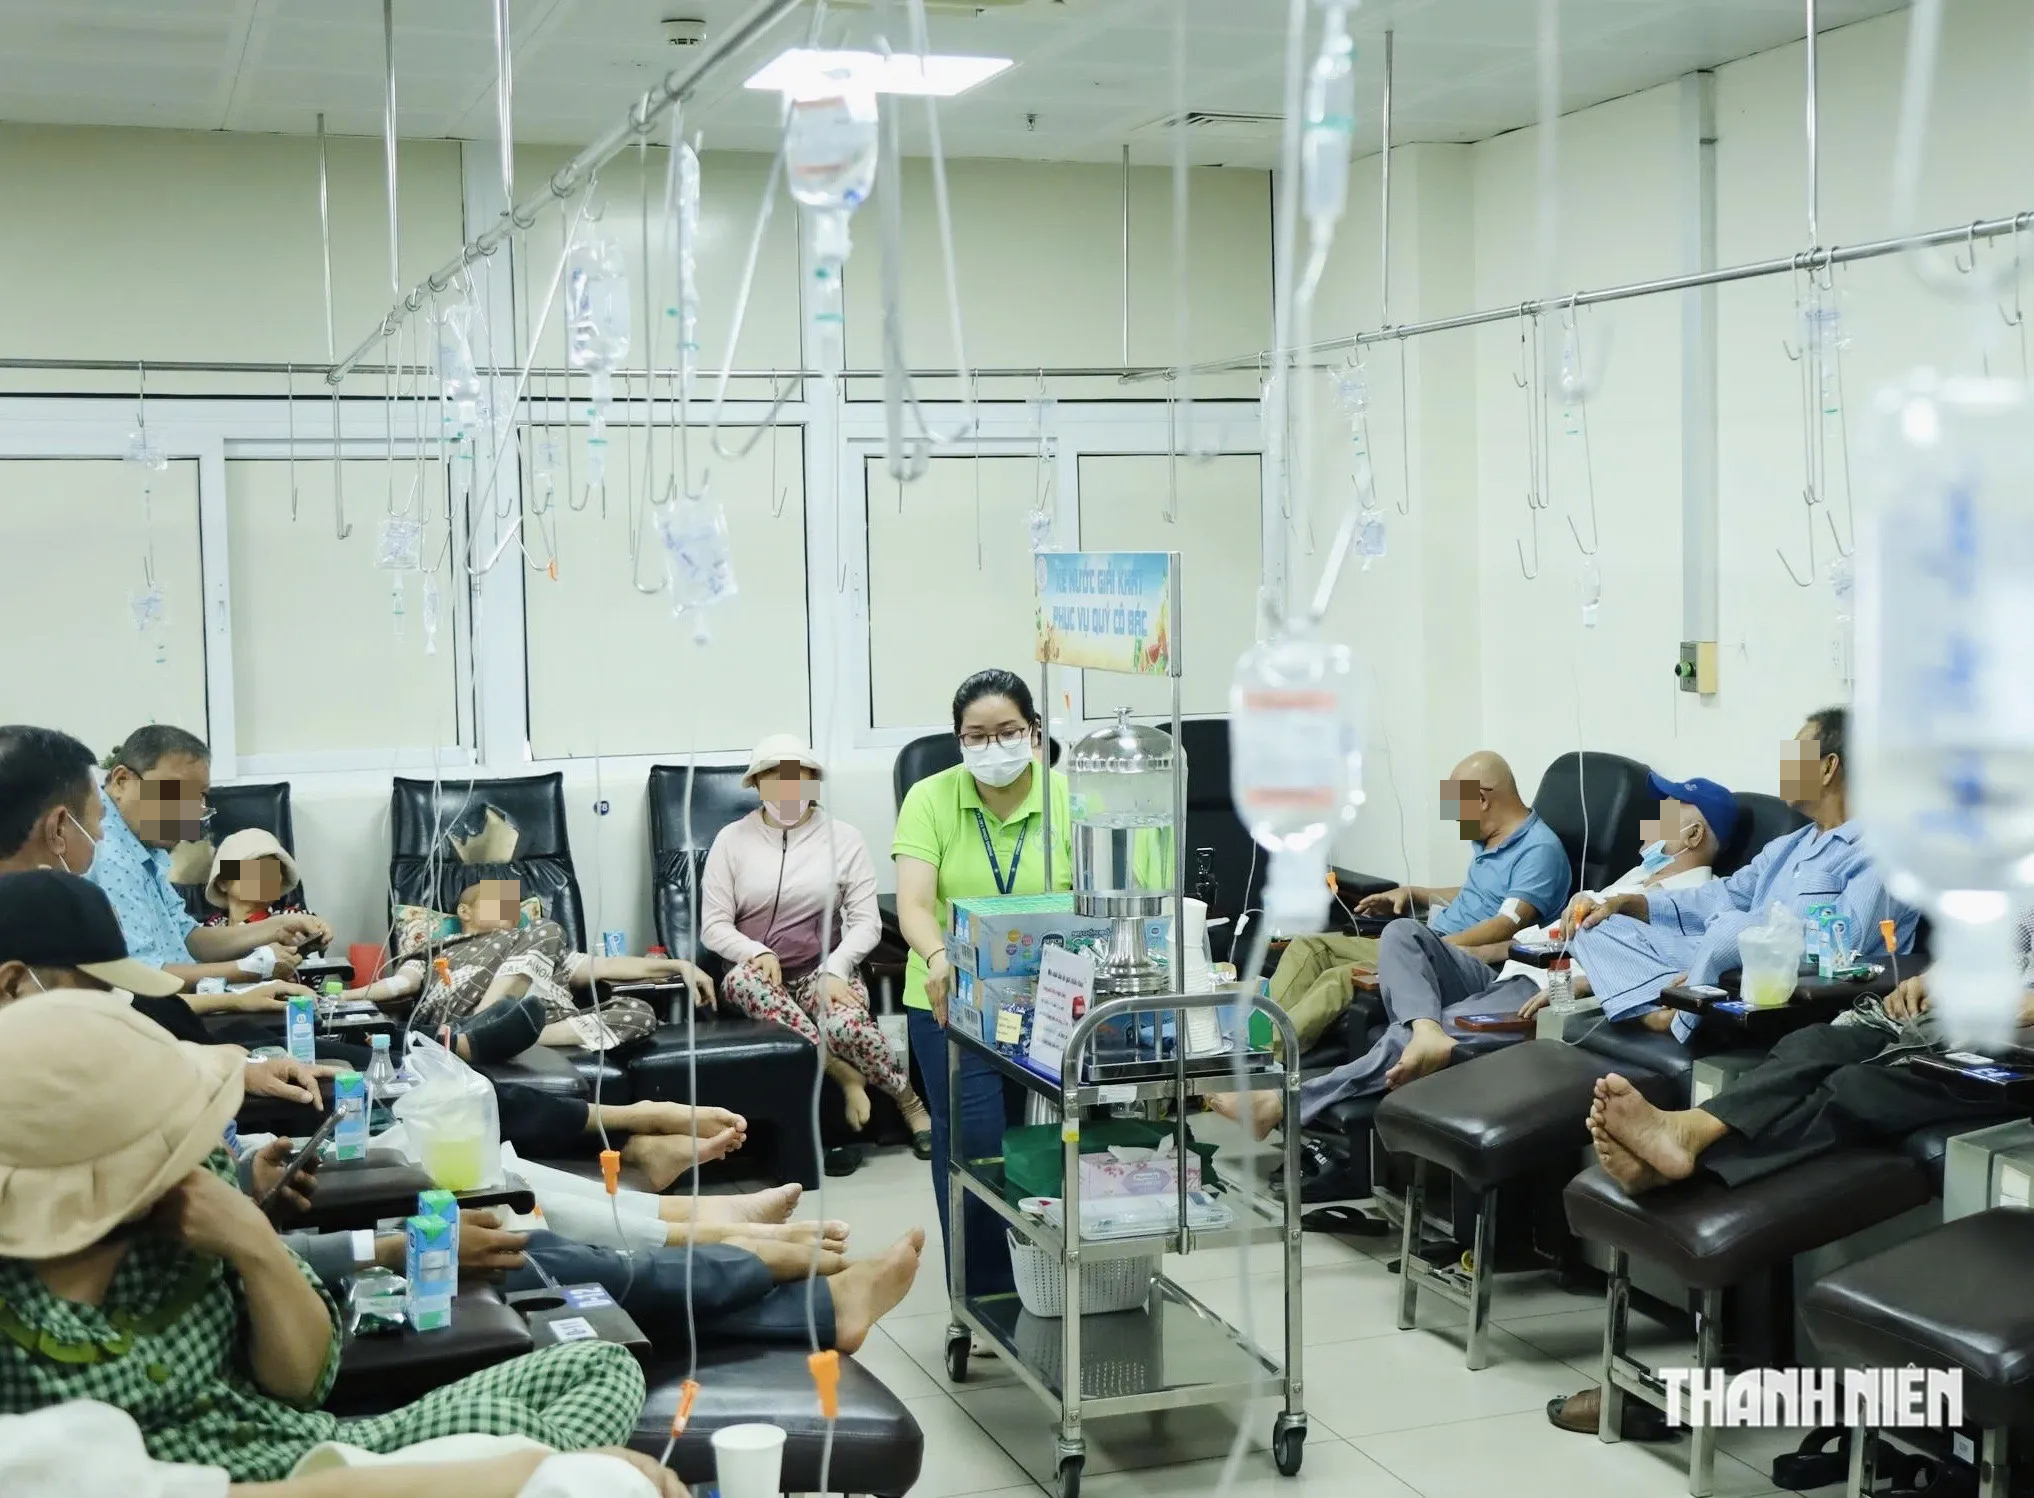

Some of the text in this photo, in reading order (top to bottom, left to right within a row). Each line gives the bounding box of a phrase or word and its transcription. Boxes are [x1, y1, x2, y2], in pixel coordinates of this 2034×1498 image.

[1053, 602, 1148, 638] PHỤC VỤ QUÝ CÔ BÁC
